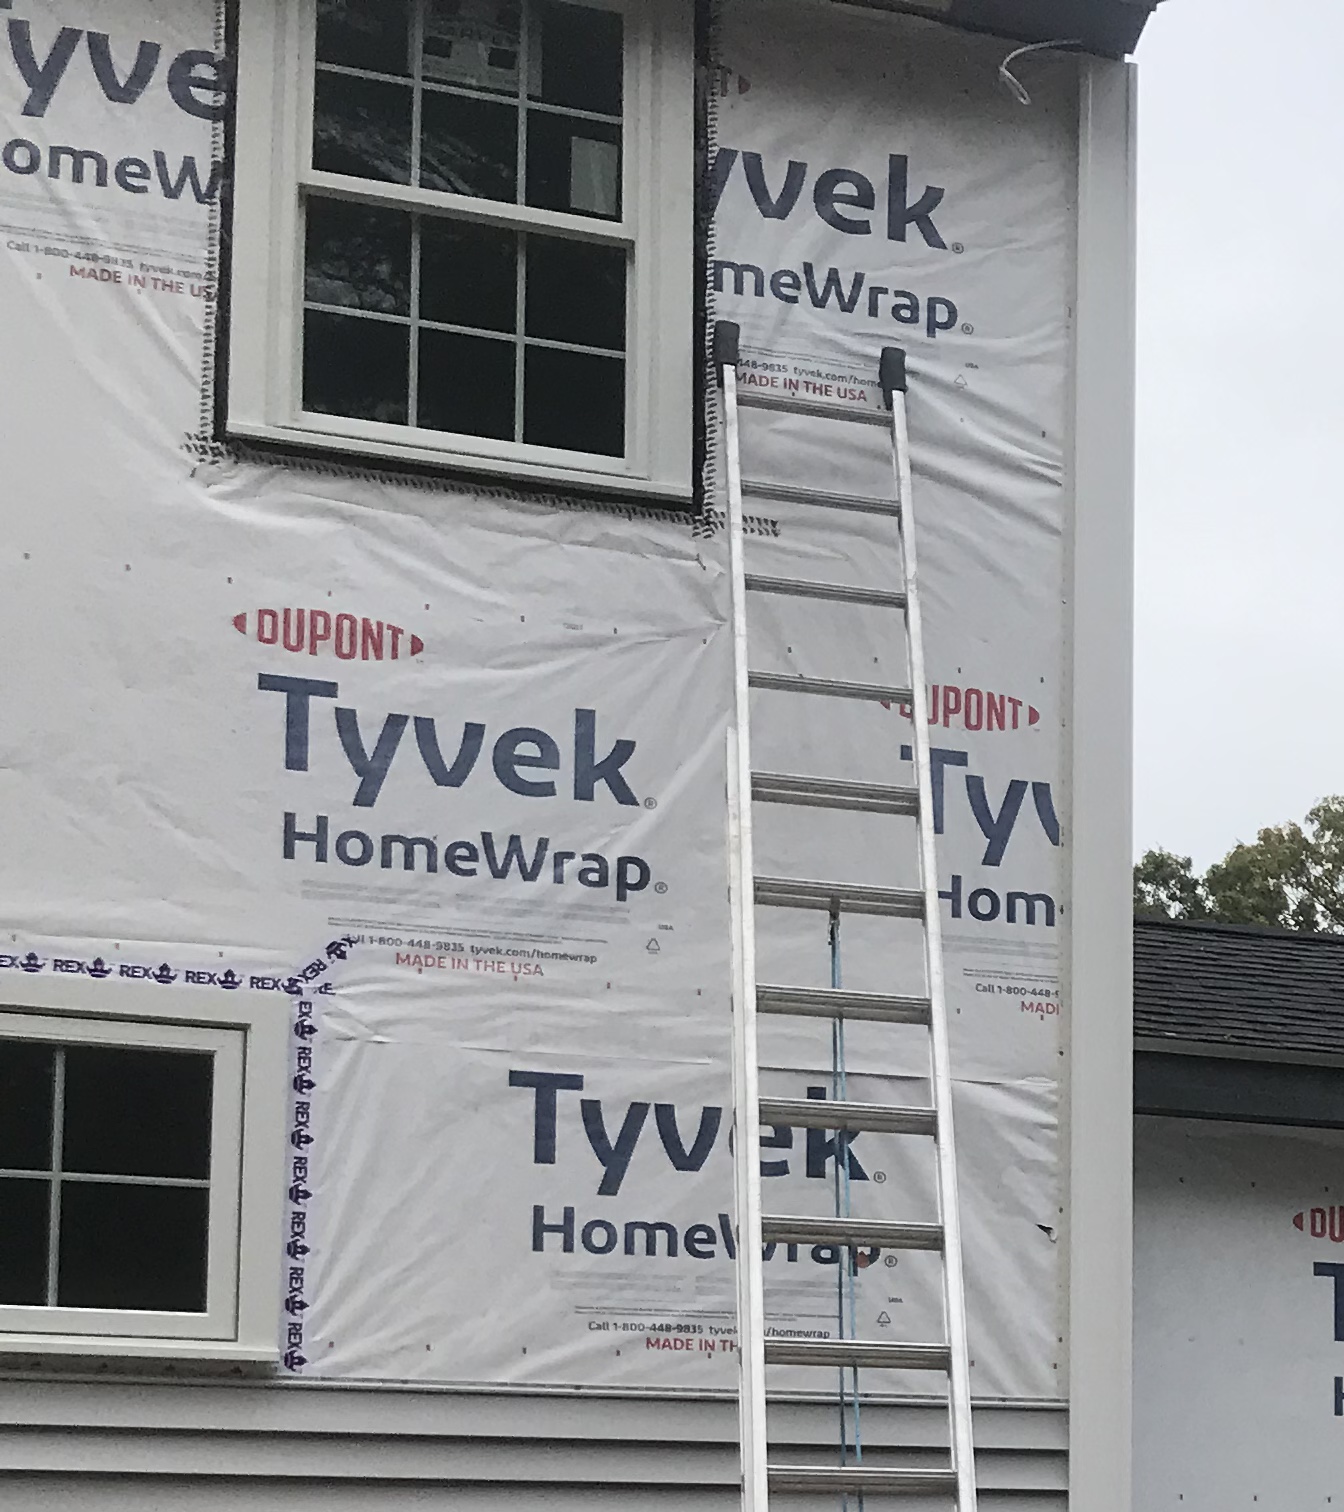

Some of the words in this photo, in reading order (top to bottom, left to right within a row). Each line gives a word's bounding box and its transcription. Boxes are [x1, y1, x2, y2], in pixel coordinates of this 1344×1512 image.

[0, 0, 224, 121] yve
[70, 264, 122, 284] MADE
[128, 274, 147, 289] IN
[151, 277, 185, 295] THE
[736, 372, 779, 389] MADE
[783, 377, 799, 391] IN
[804, 380, 833, 397] THE
[836, 386, 867, 402] USA
[257, 608, 404, 661] DUPONT
[900, 684, 1022, 732] UPONT
[257, 673, 640, 808] Tyvek
[281, 812, 653, 902] HomeWrap
[0, 955, 19, 968] EX
[53, 959, 86, 974] REX
[119, 964, 152, 979] REX
[185, 969, 218, 985] REX
[250, 975, 281, 991] REX
[395, 952, 447, 969] MADE
[452, 957, 470, 970] IN
[475, 959, 507, 973] THE
[511, 962, 544, 977] USA
[975, 982, 995, 995] Call
[298, 1001, 313, 1019] EX
[297, 1046, 312, 1079] REX
[295, 1101, 310, 1134] REX
[293, 1156, 308, 1189] REX
[291, 1211, 306, 1244] REX
[289, 1266, 304, 1299] REX
[287, 1322, 303, 1355] REX
[588, 1320, 609, 1332] Call
[645, 1337, 693, 1351] MADE
[699, 1339, 715, 1352] IN
[719, 1340, 739, 1353] TH
